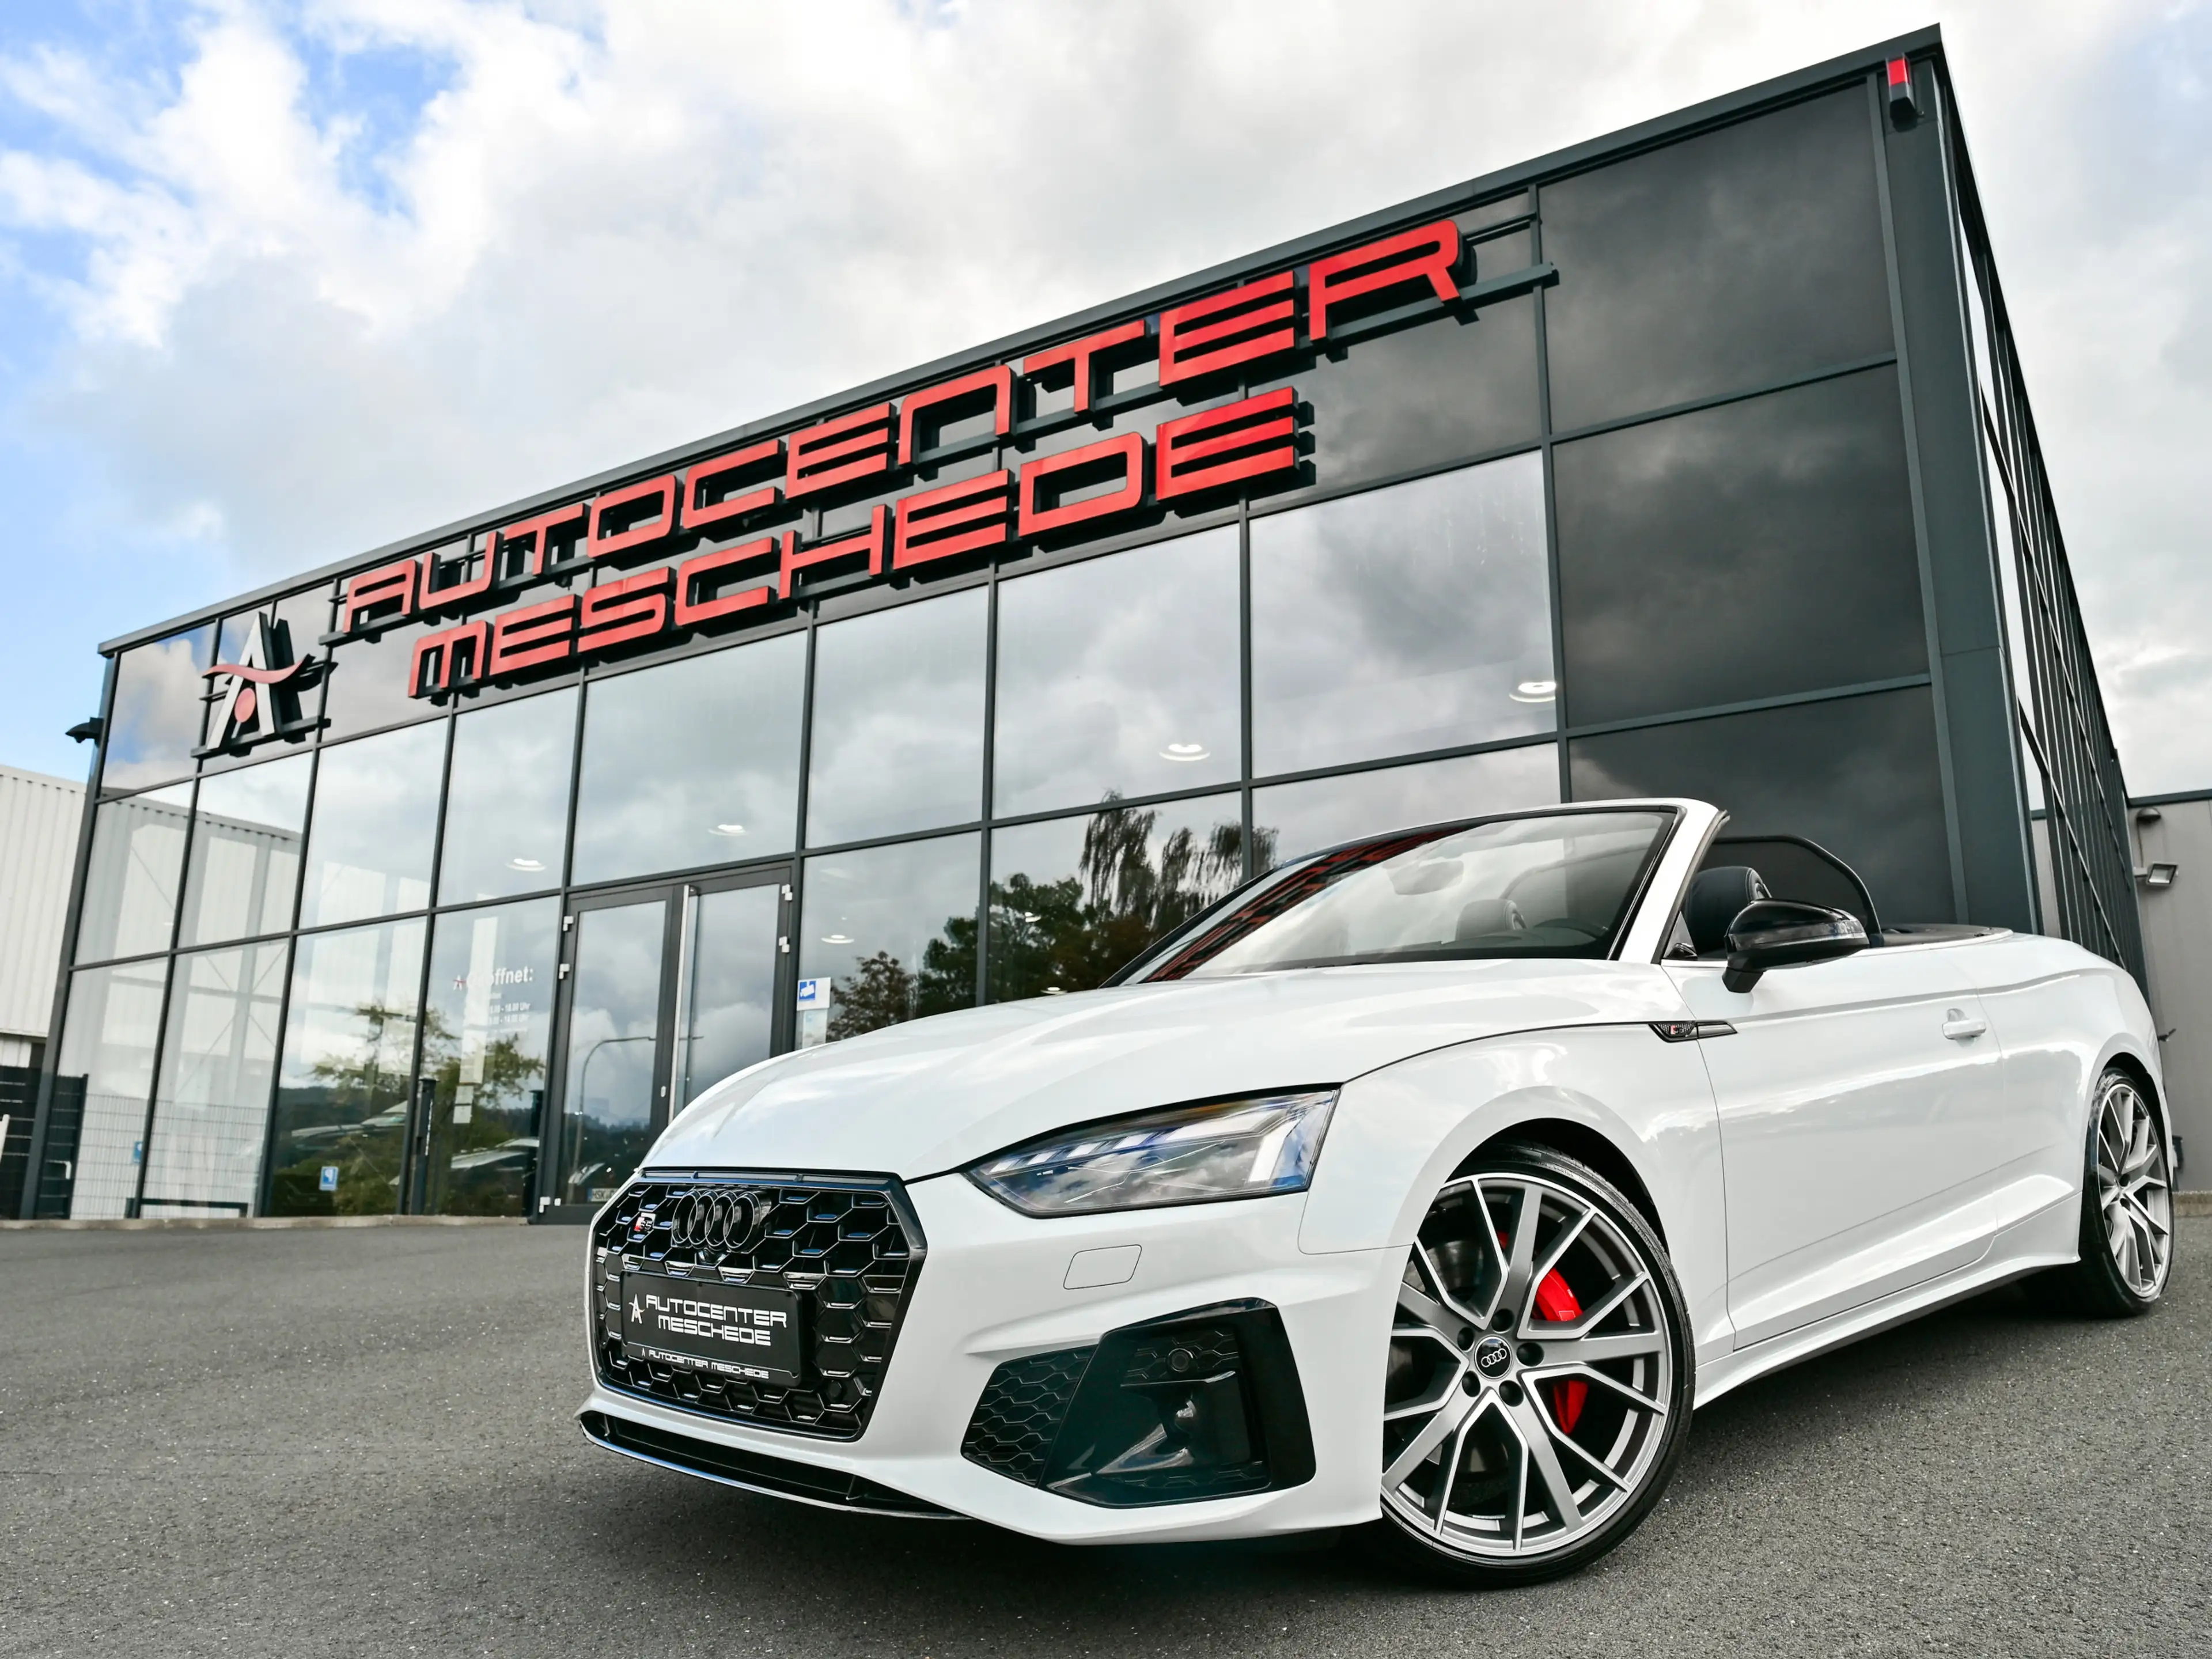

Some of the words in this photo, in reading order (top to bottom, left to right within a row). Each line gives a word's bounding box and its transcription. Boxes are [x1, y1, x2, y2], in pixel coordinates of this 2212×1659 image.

[343, 219, 1460, 634] AUTOCENTER
[408, 387, 1294, 698] MESCHEDE
[466, 965, 533, 988] Gffnet:
[646, 1294, 787, 1328] AUTOCENTER
[658, 1315, 771, 1346] MESCHEDE
[649, 1349, 709, 1368] AUTOCENTER
[711, 1361, 770, 1379] MESCHEDE
